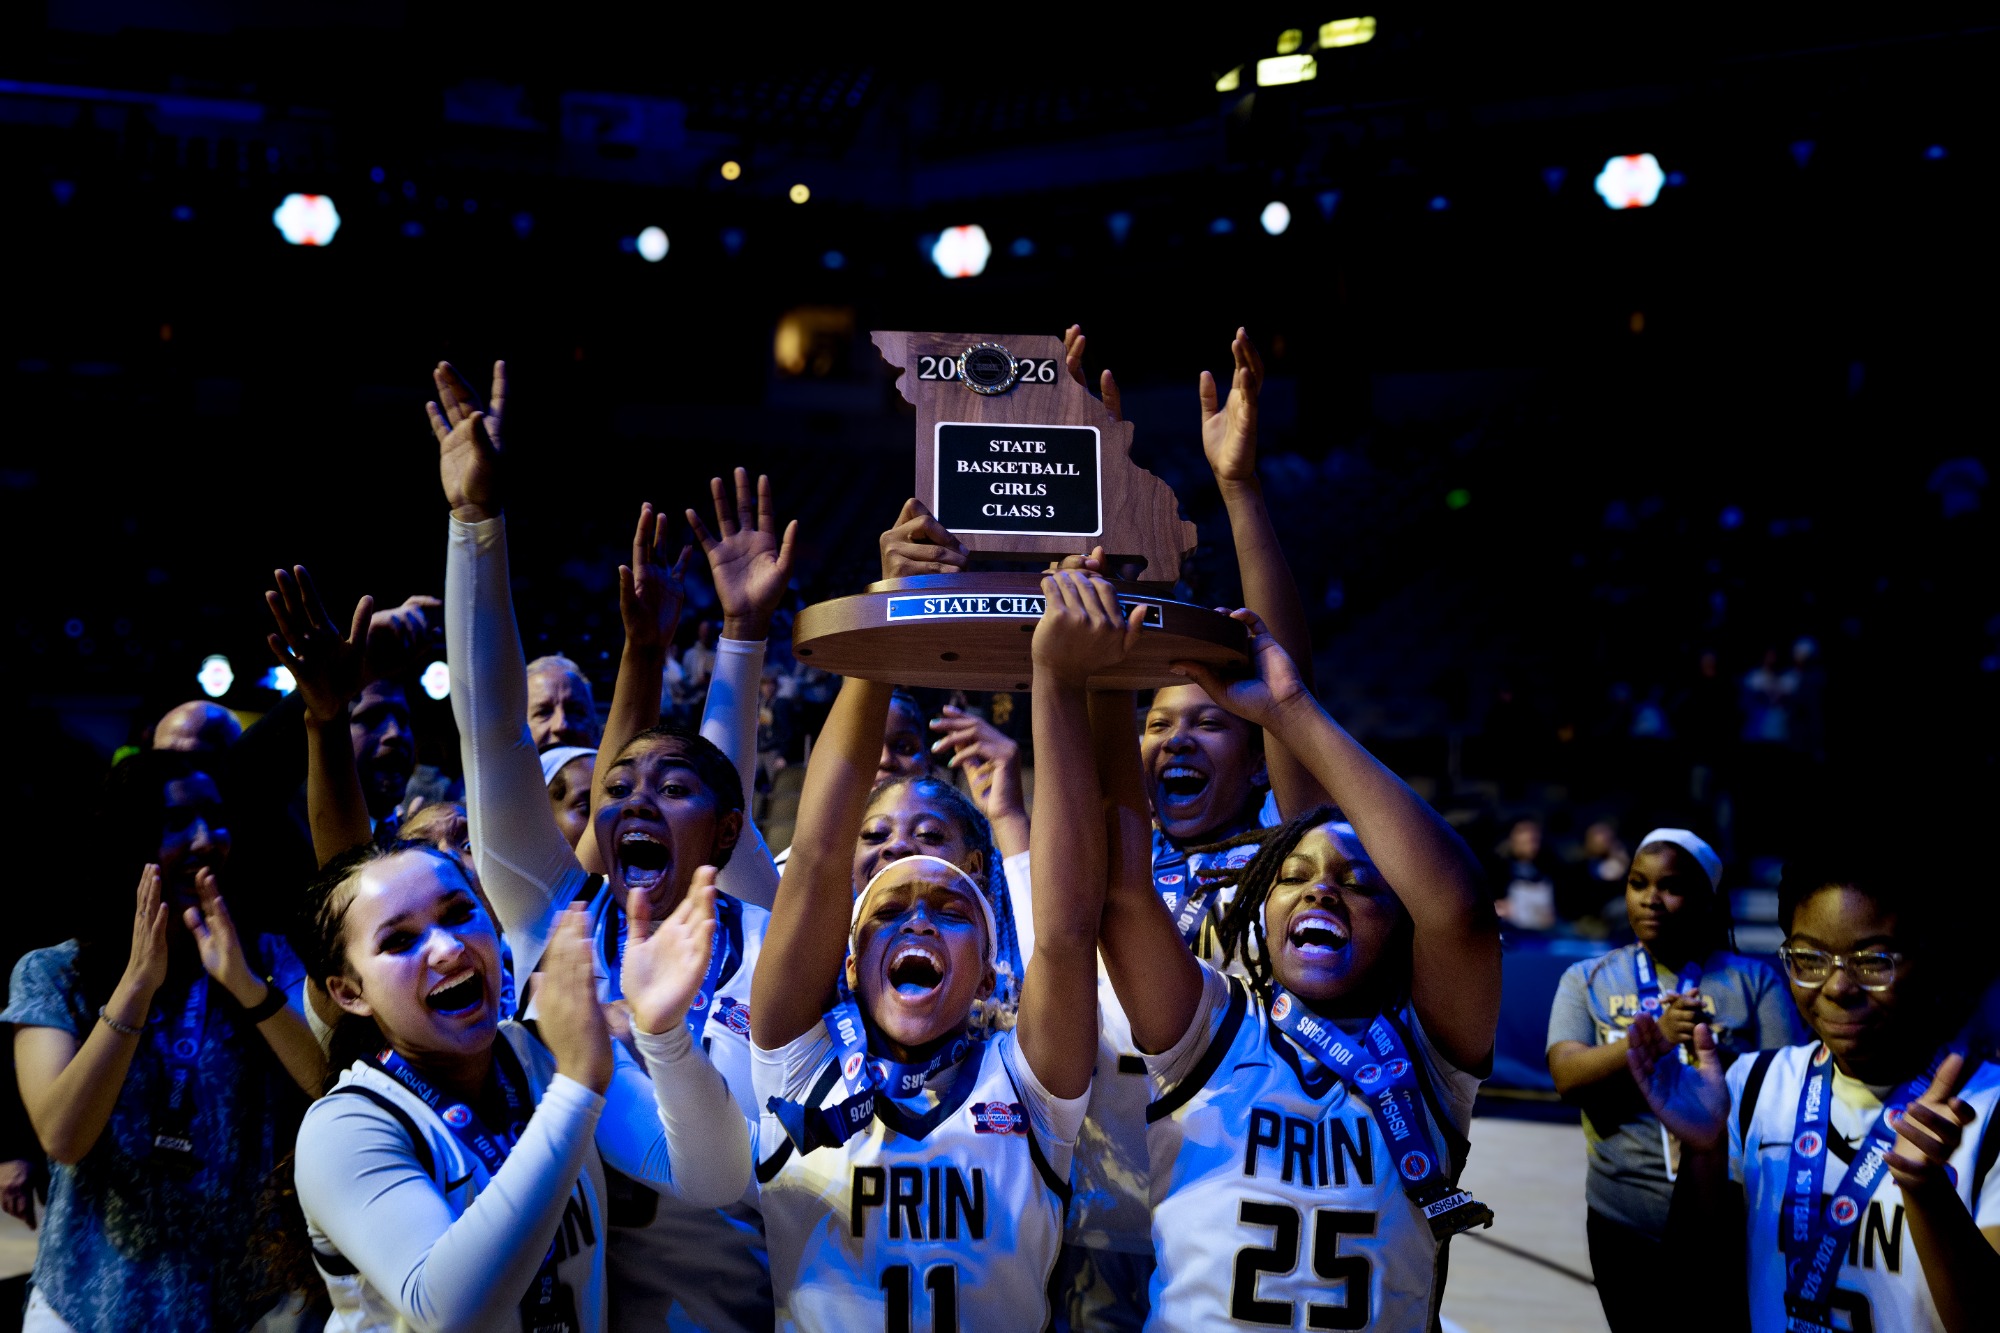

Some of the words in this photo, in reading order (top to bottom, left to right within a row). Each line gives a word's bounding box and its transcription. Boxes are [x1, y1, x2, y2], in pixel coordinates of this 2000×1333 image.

[919, 356, 956, 380] 20
[1019, 358, 1056, 383] 26
[988, 439, 1047, 454] STATE
[956, 460, 1081, 476] BASKETBALL
[989, 482, 1047, 497] GIRLS
[981, 504, 1042, 518] CLASS
[1045, 504, 1055, 518] 3
[923, 598, 990, 615] STATE
[1296, 1015, 1330, 1049] YEARS
[1368, 1021, 1395, 1057] YEARS
[1327, 1041, 1355, 1067] 100
[394, 1065, 441, 1110] MSHSAA
[1377, 1086, 1411, 1142] MSHSAA
[473, 1134, 497, 1160] 100
[1242, 1107, 1376, 1189] PRIN
[850, 1165, 985, 1240] PRIN
[1427, 1193, 1465, 1216] MSHSAA
[1230, 1198, 1378, 1331] 25
[879, 1263, 960, 1333] 11
